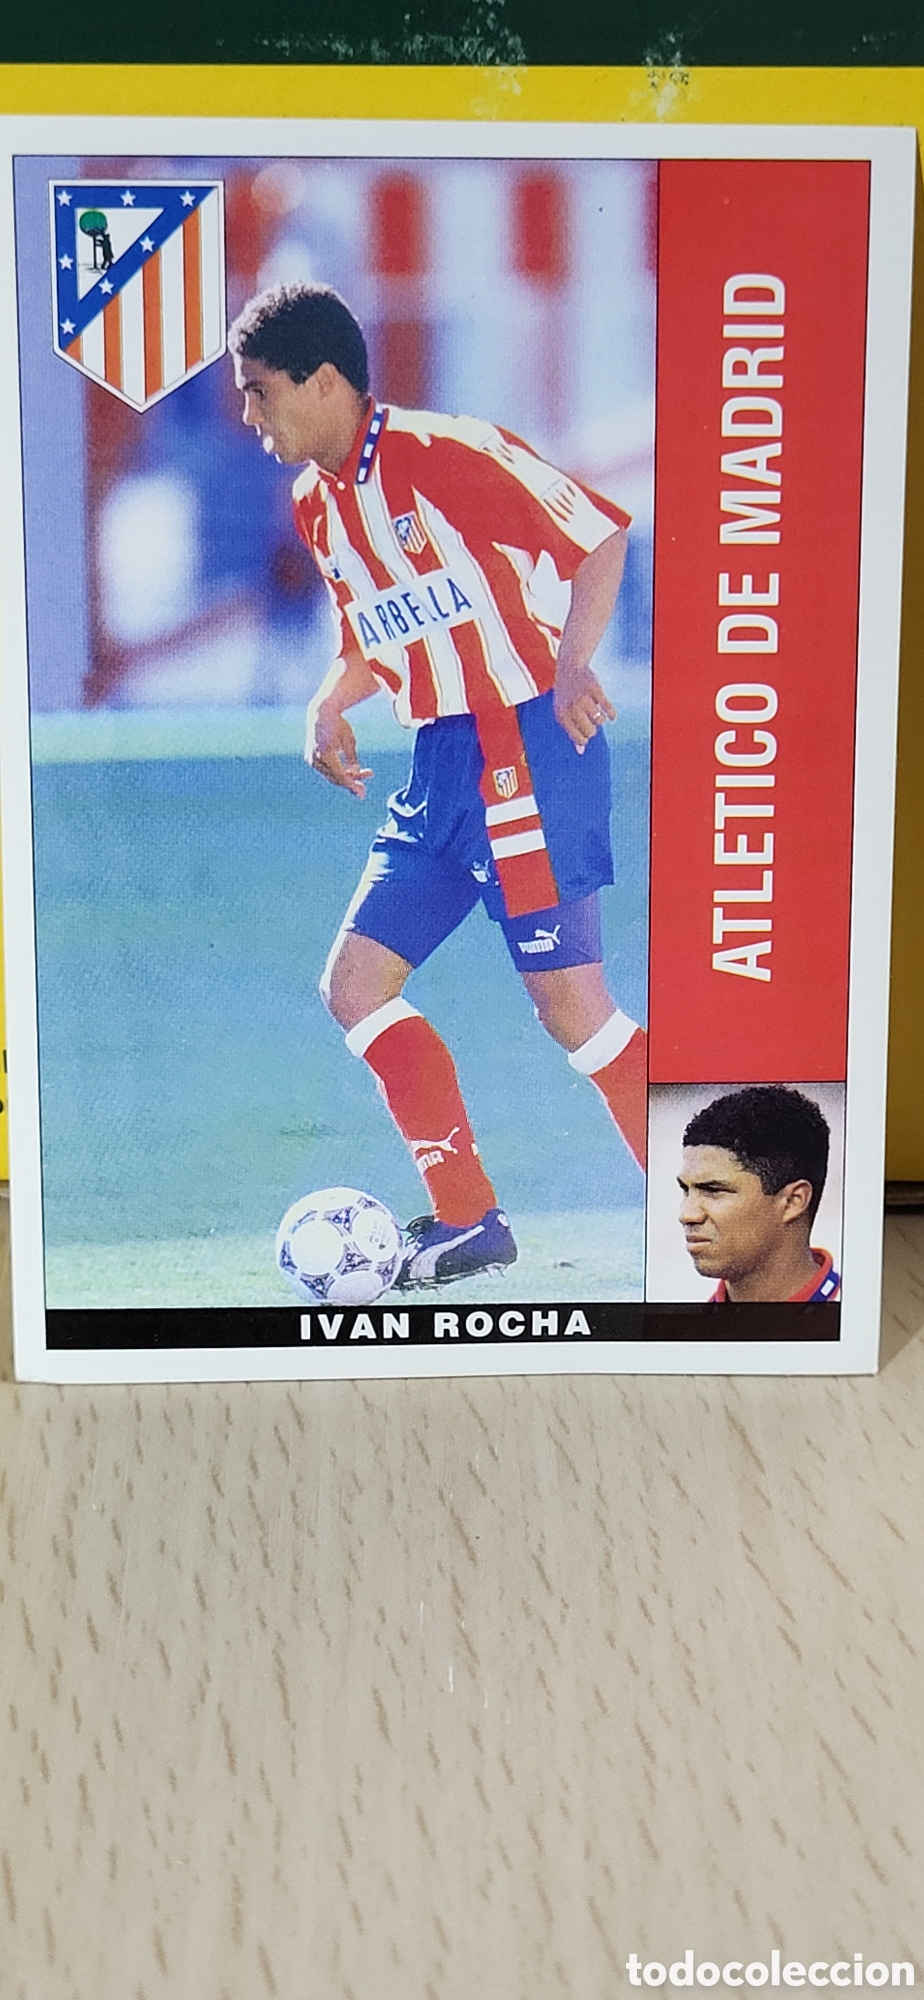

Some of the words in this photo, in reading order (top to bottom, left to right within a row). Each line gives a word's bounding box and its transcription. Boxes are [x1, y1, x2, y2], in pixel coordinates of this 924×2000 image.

[719, 273, 786, 545] MADRID
[717, 572, 780, 654] DE
[712, 683, 779, 983] ATLETICO
[300, 1312, 410, 1341] IVAN
[433, 1309, 592, 1339] ROCHA
